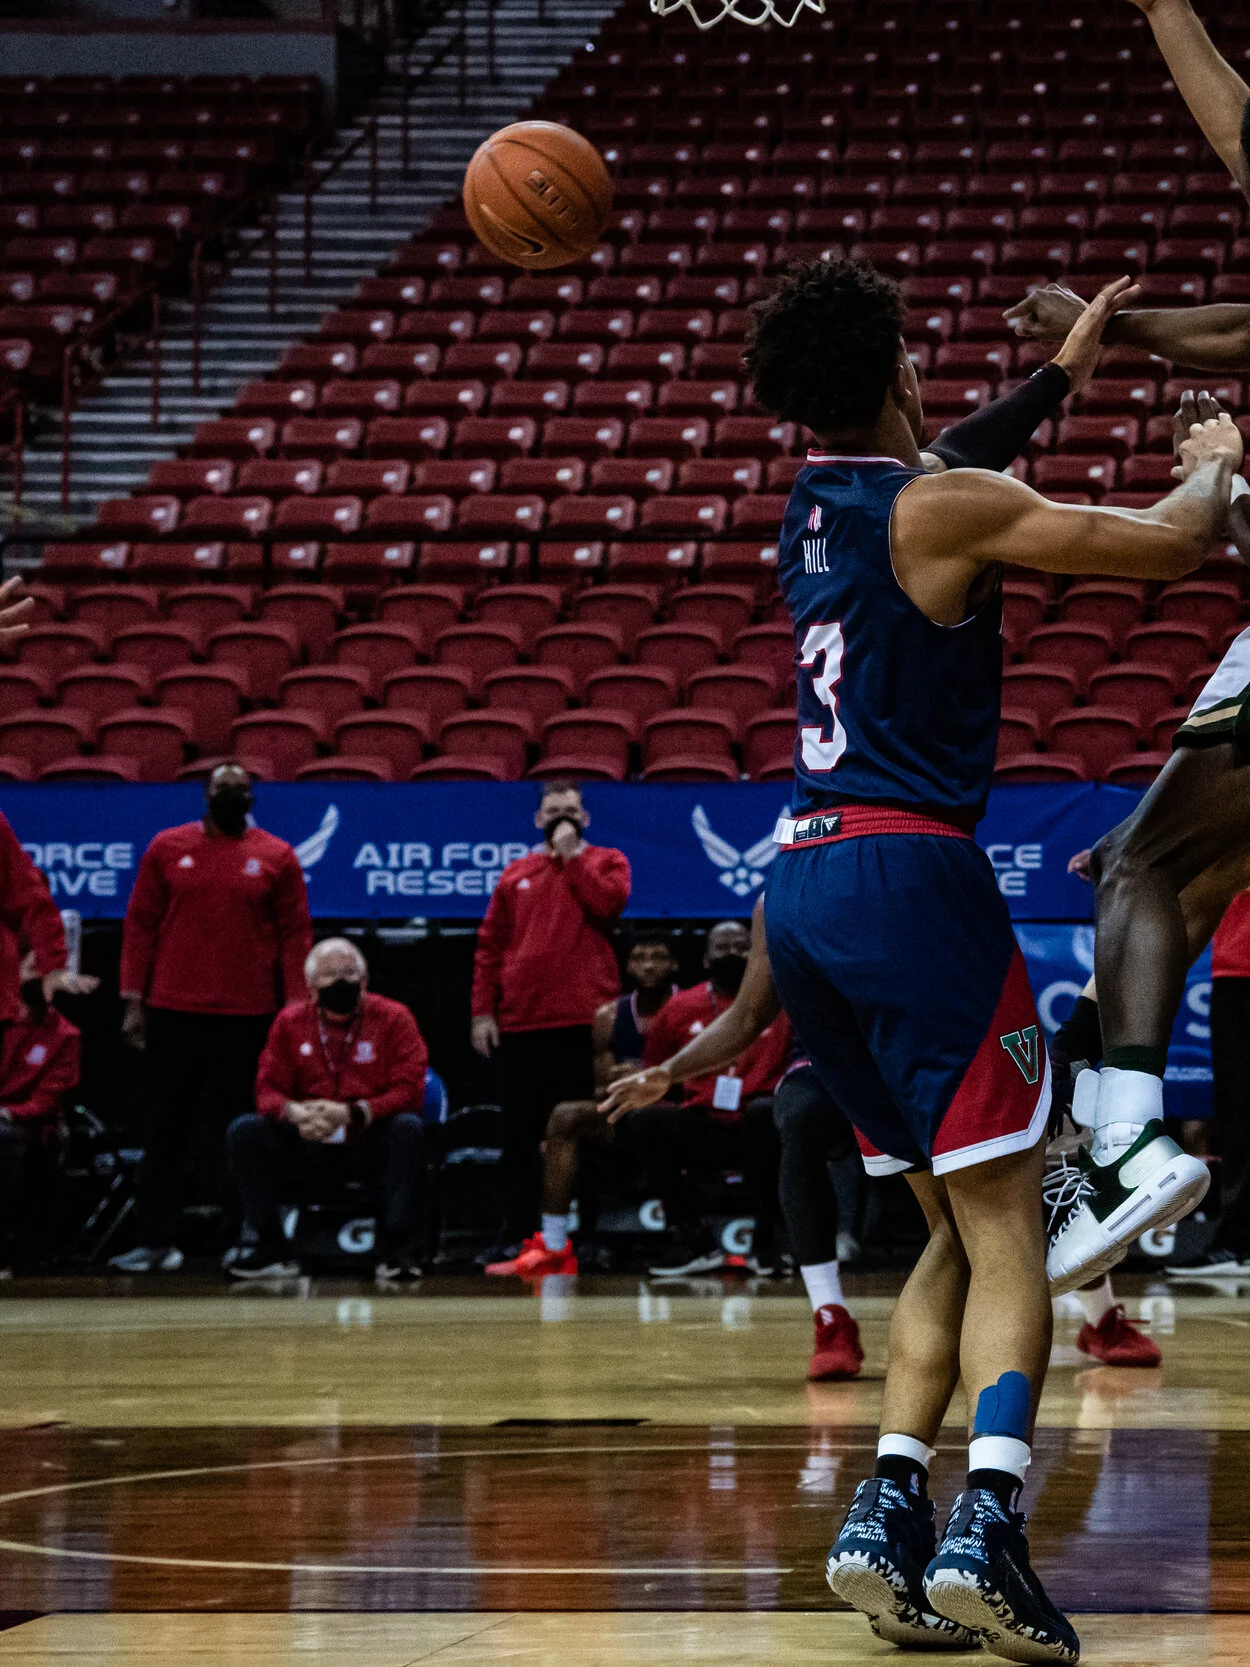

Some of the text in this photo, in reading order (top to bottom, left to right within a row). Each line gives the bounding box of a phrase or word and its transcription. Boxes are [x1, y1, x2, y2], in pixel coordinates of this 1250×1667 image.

[803, 538, 830, 574] HILL
[799, 621, 848, 773] 3
[22, 842, 133, 869] ORCE
[353, 842, 432, 869] AIR
[366, 870, 501, 896] RESE
[1000, 1025, 1039, 1085] V
